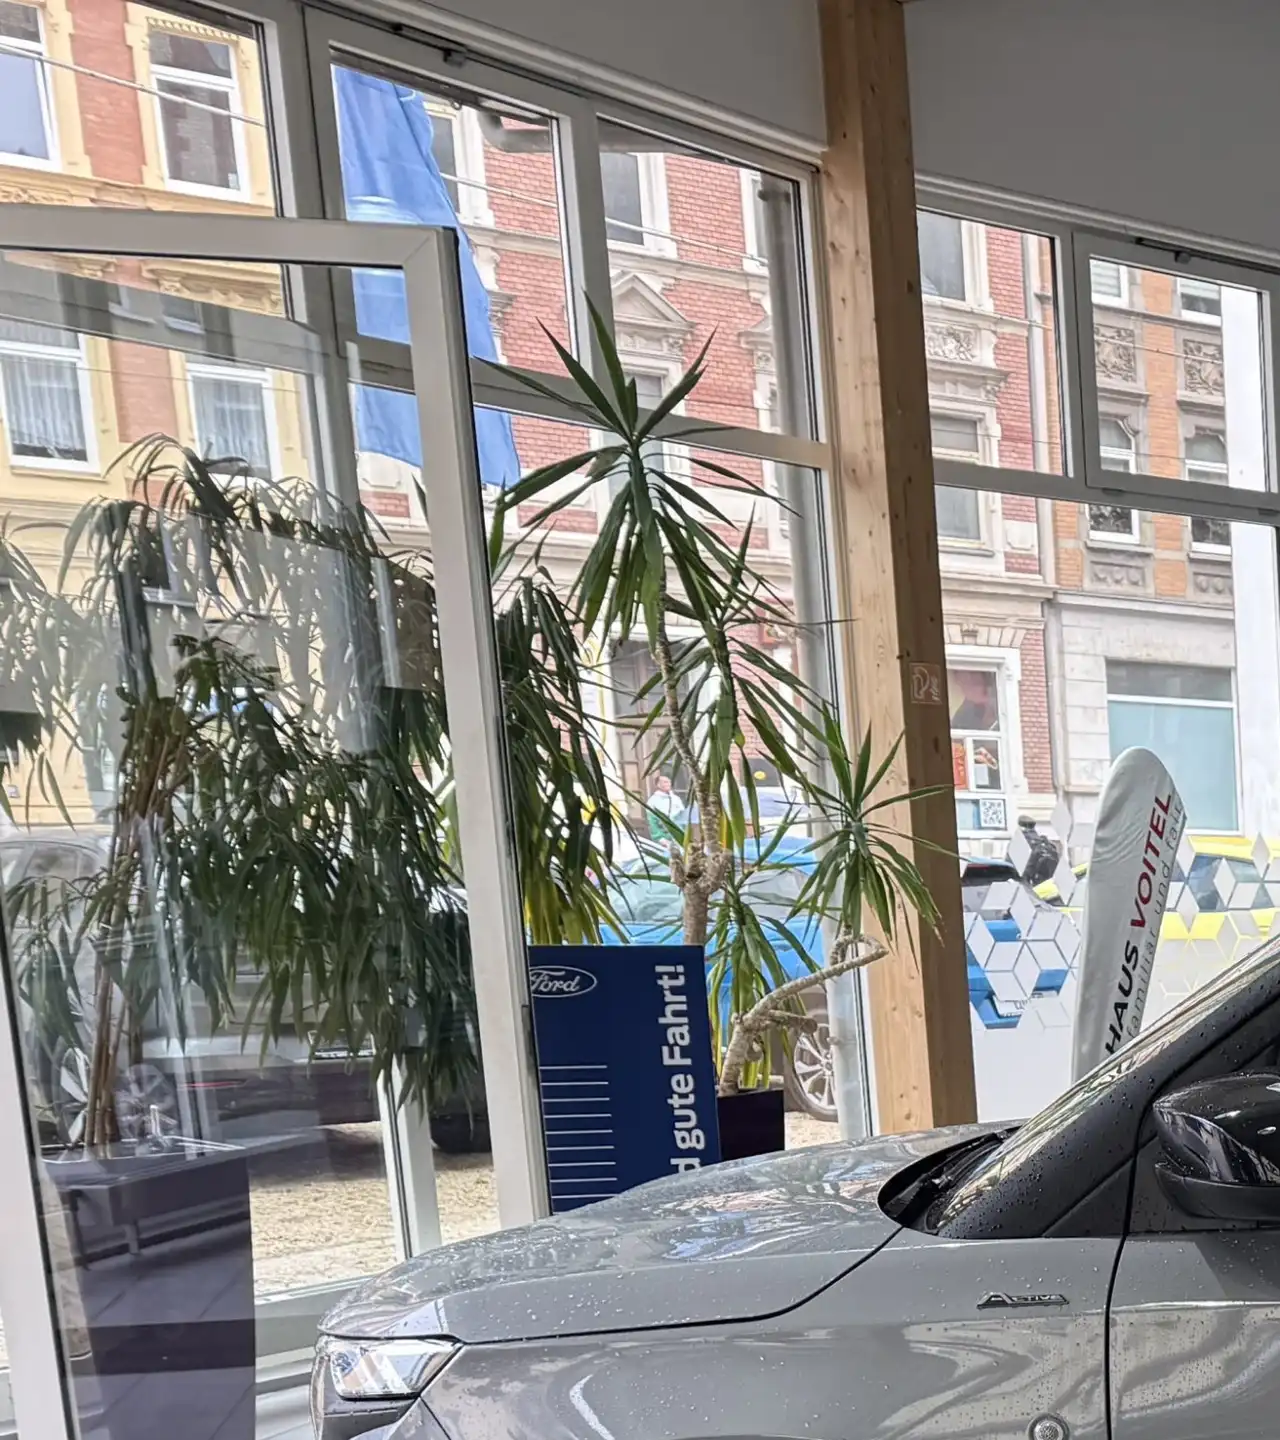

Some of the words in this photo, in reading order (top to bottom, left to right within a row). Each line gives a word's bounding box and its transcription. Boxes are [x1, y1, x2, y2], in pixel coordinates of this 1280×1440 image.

[1130, 793, 1172, 928] VOITEL
[530, 970, 581, 992] Ford
[1127, 927, 1158, 1039] familiar
[1155, 860, 1171, 915] und
[655, 964, 692, 1066] Fahrt!
[667, 1073, 706, 1150] gute
